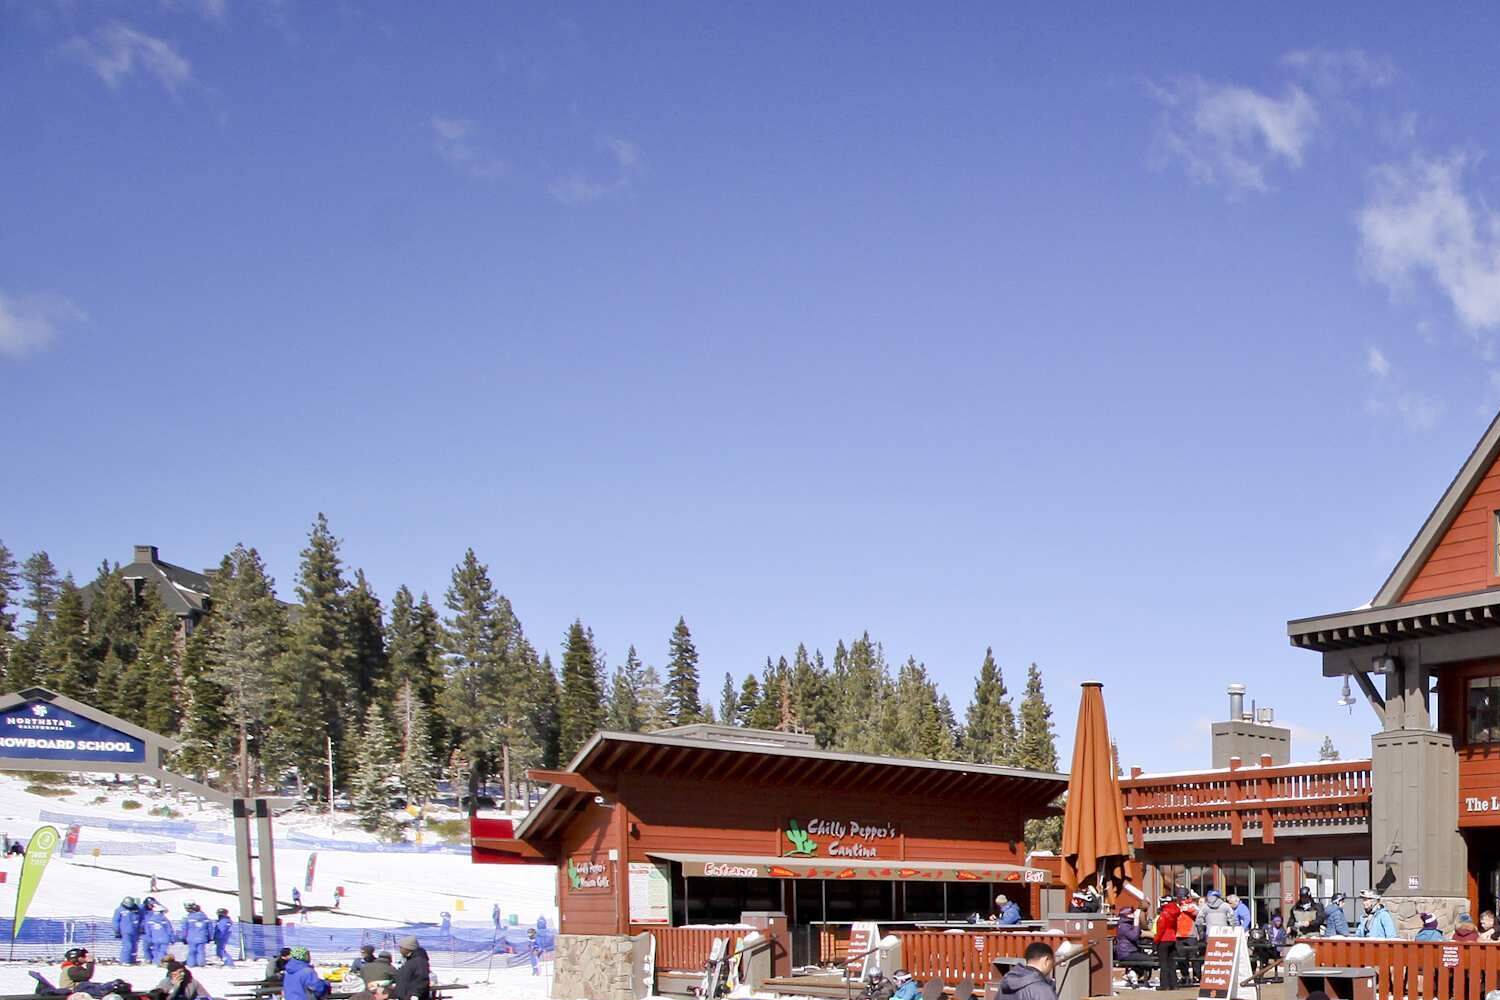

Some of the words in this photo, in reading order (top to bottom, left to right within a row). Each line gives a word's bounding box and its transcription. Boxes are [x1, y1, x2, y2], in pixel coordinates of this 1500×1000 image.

[6, 717, 73, 728] NORTHSTAR
[77, 741, 134, 752] SCHOOL
[1465, 797, 1488, 811] The
[807, 819, 846, 838] Chilly
[850, 821, 895, 840] Pepper's
[828, 842, 877, 857] Cantina
[704, 862, 758, 877] Entrance
